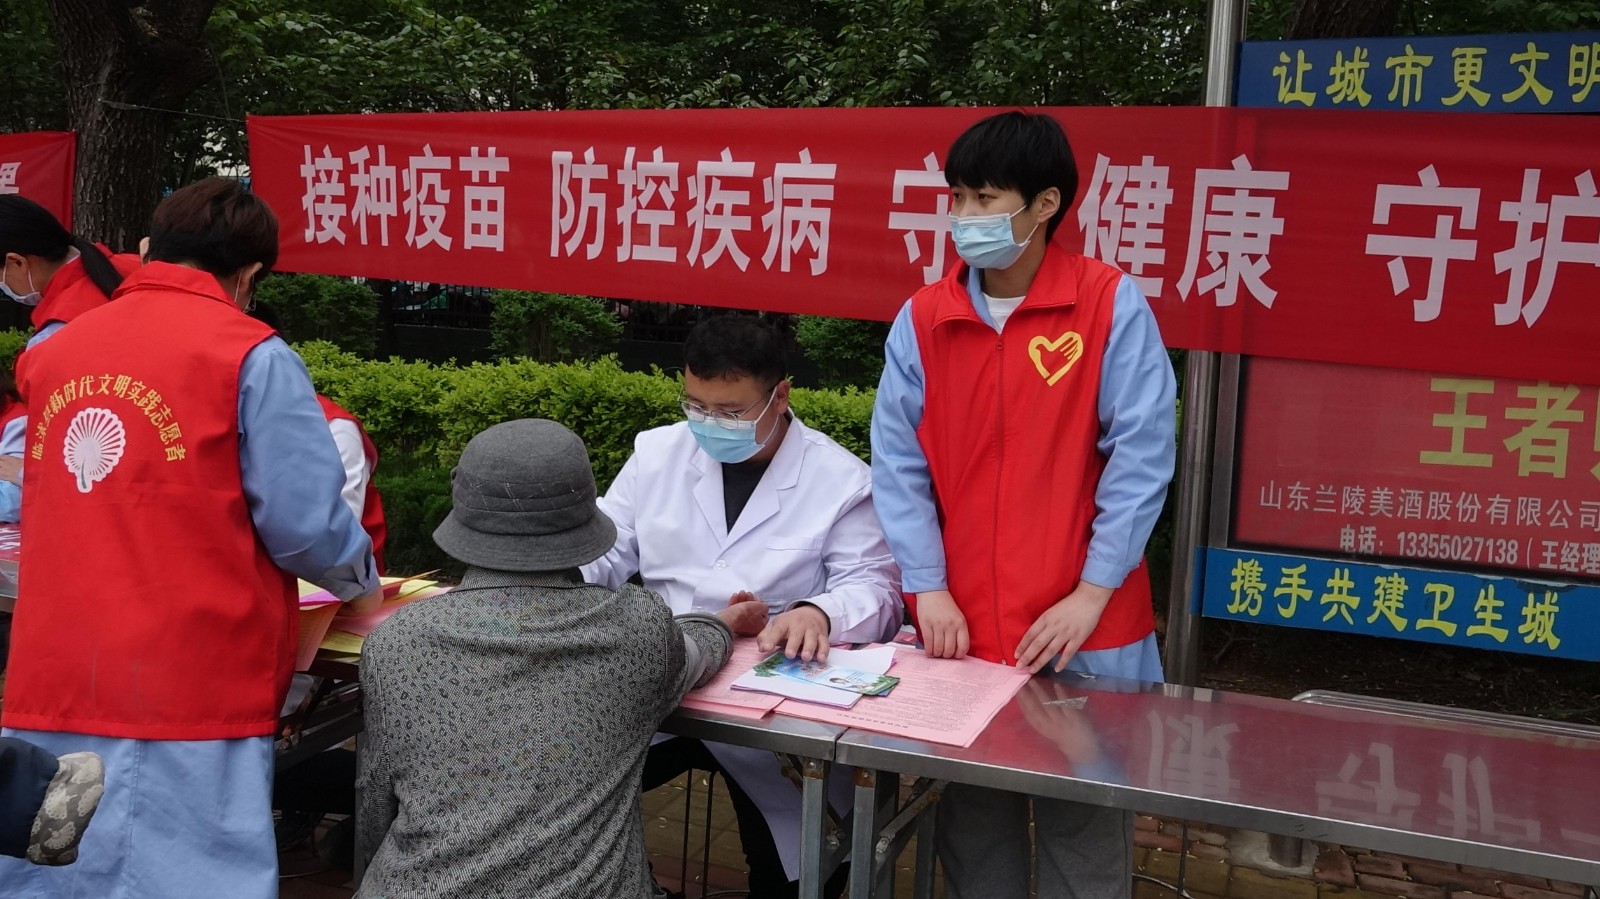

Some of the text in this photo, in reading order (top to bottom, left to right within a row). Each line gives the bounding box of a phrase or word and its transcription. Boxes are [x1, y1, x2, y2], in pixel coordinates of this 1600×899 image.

[1272, 41, 1600, 108] 让城市更文明
[300, 143, 510, 252] 接种疫苗
[550, 146, 837, 276] 防控疾病
[1419, 377, 1600, 480] 王者
[1259, 479, 1600, 533] 山东兰陵美酒股份有限公司
[1226, 557, 1562, 651] 携手共建卫生城
